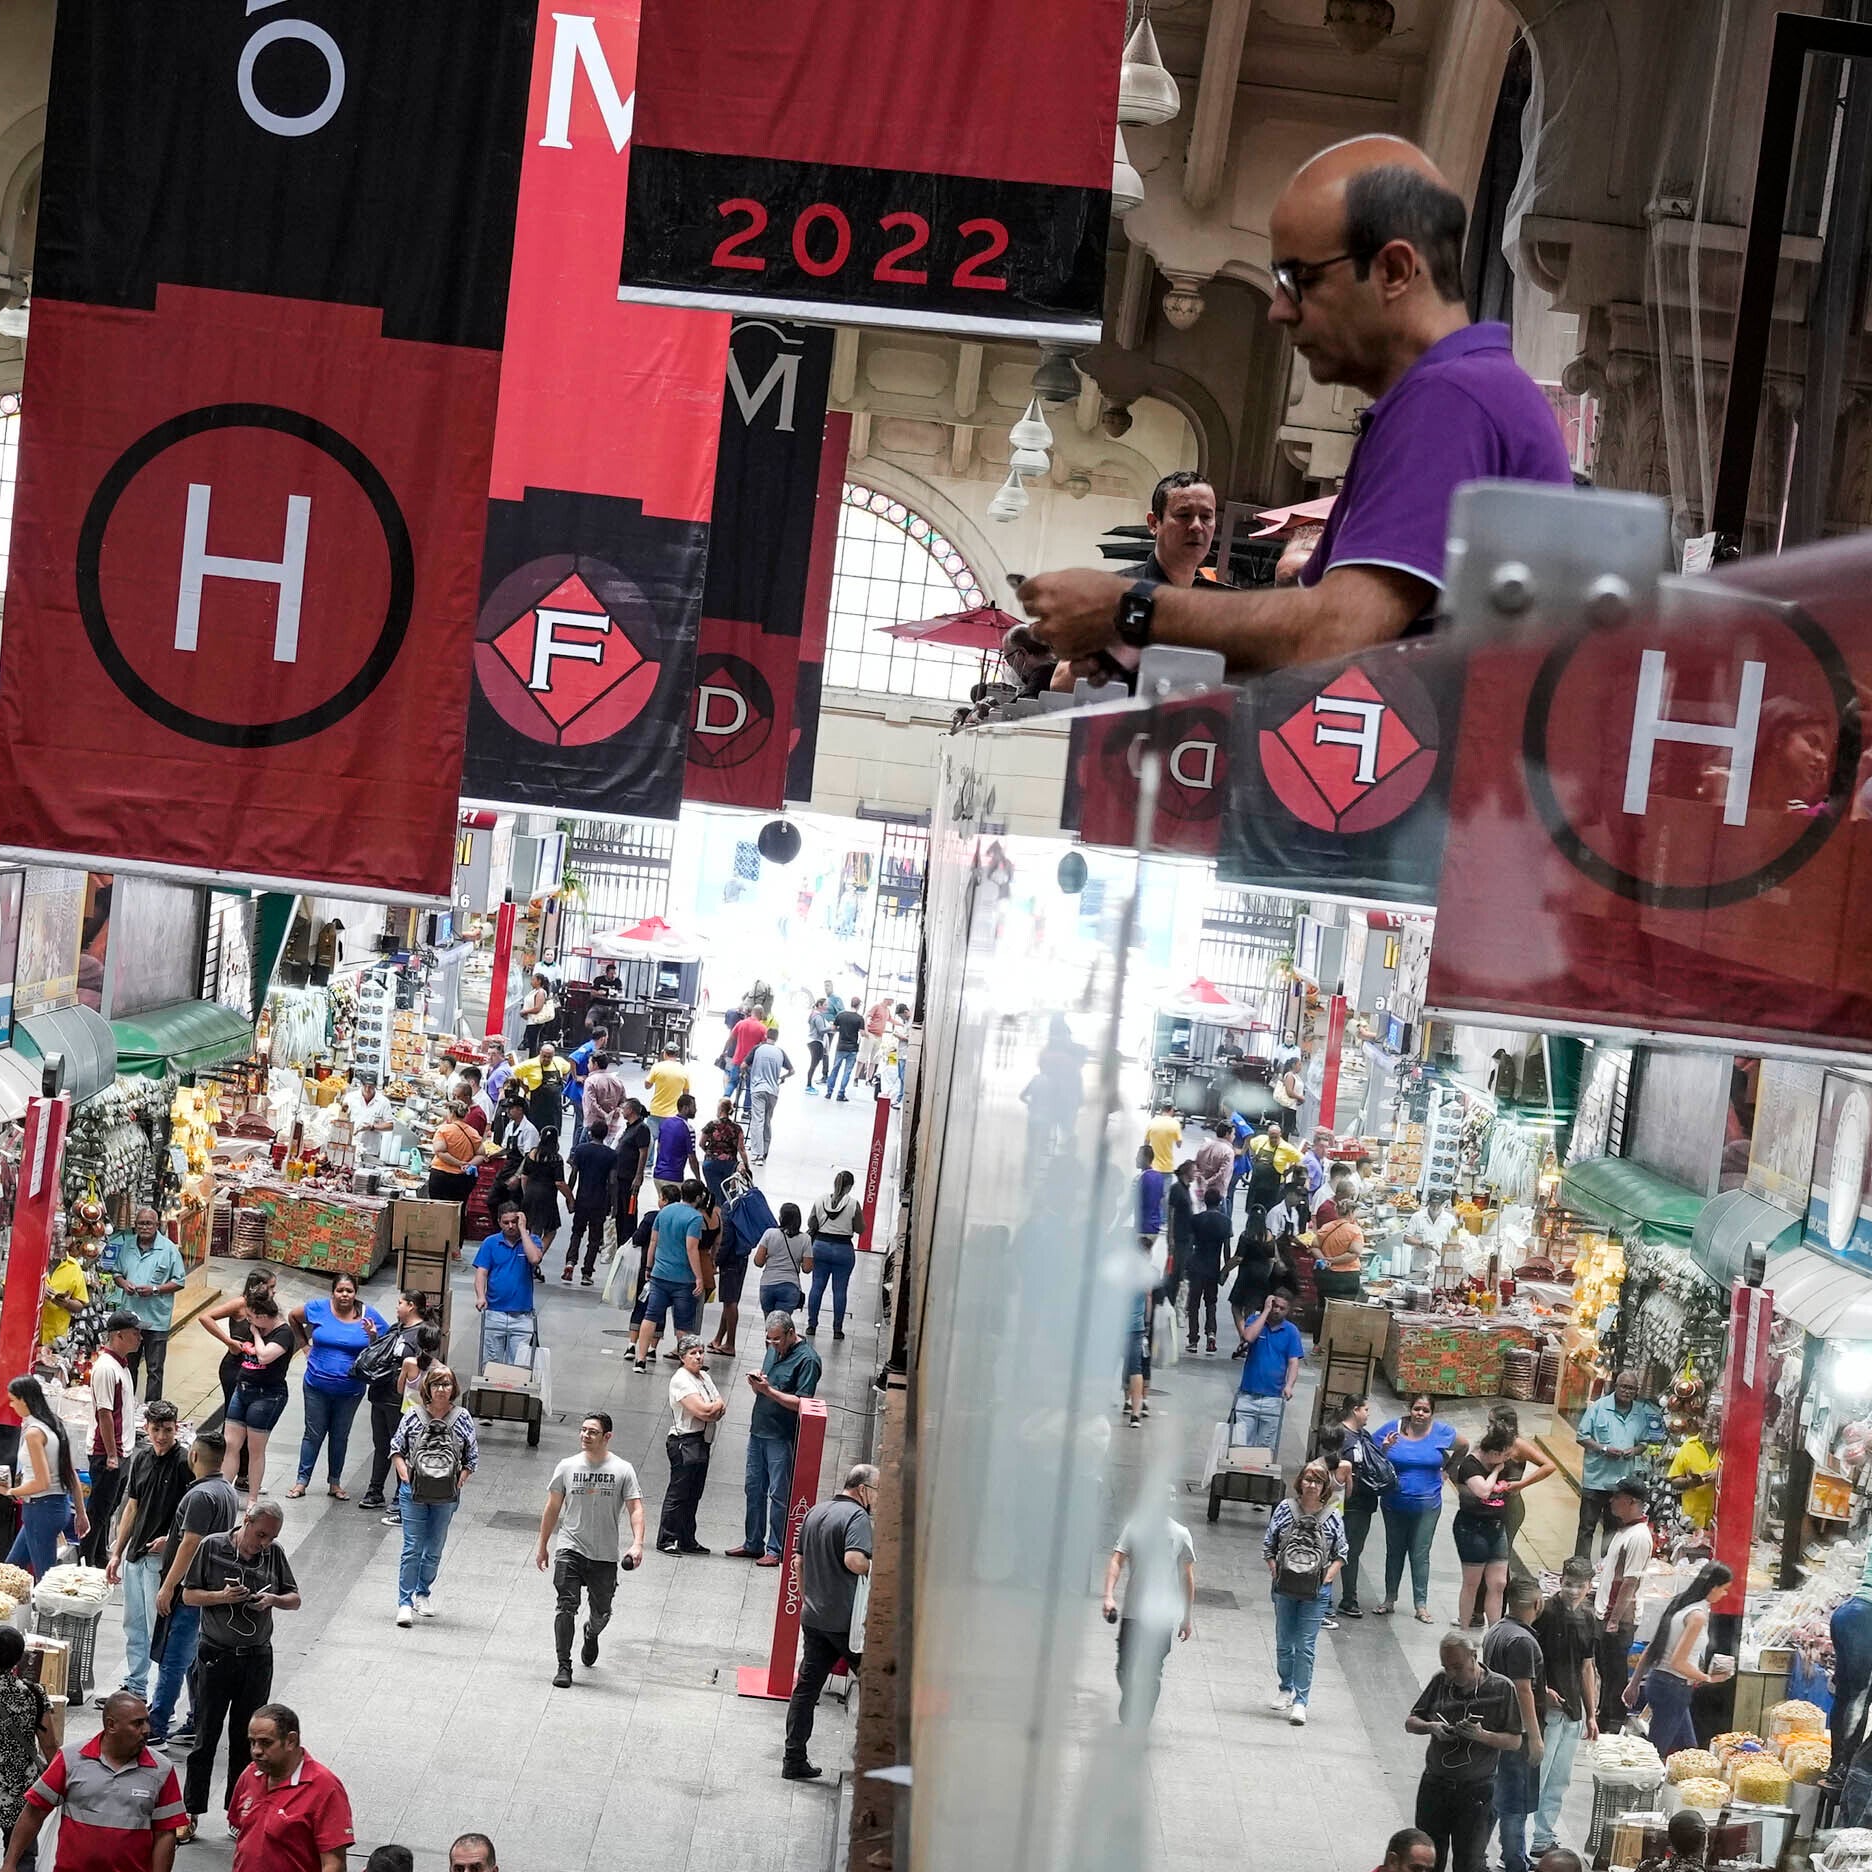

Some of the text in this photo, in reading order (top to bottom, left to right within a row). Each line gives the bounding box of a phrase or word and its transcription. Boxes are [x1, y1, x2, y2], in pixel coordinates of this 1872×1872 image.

[710, 198, 1010, 292] 2022
[174, 483, 312, 663] H
[528, 606, 612, 692] F
[694, 685, 748, 735] D
[573, 1472, 615, 1484] HILFIGER
